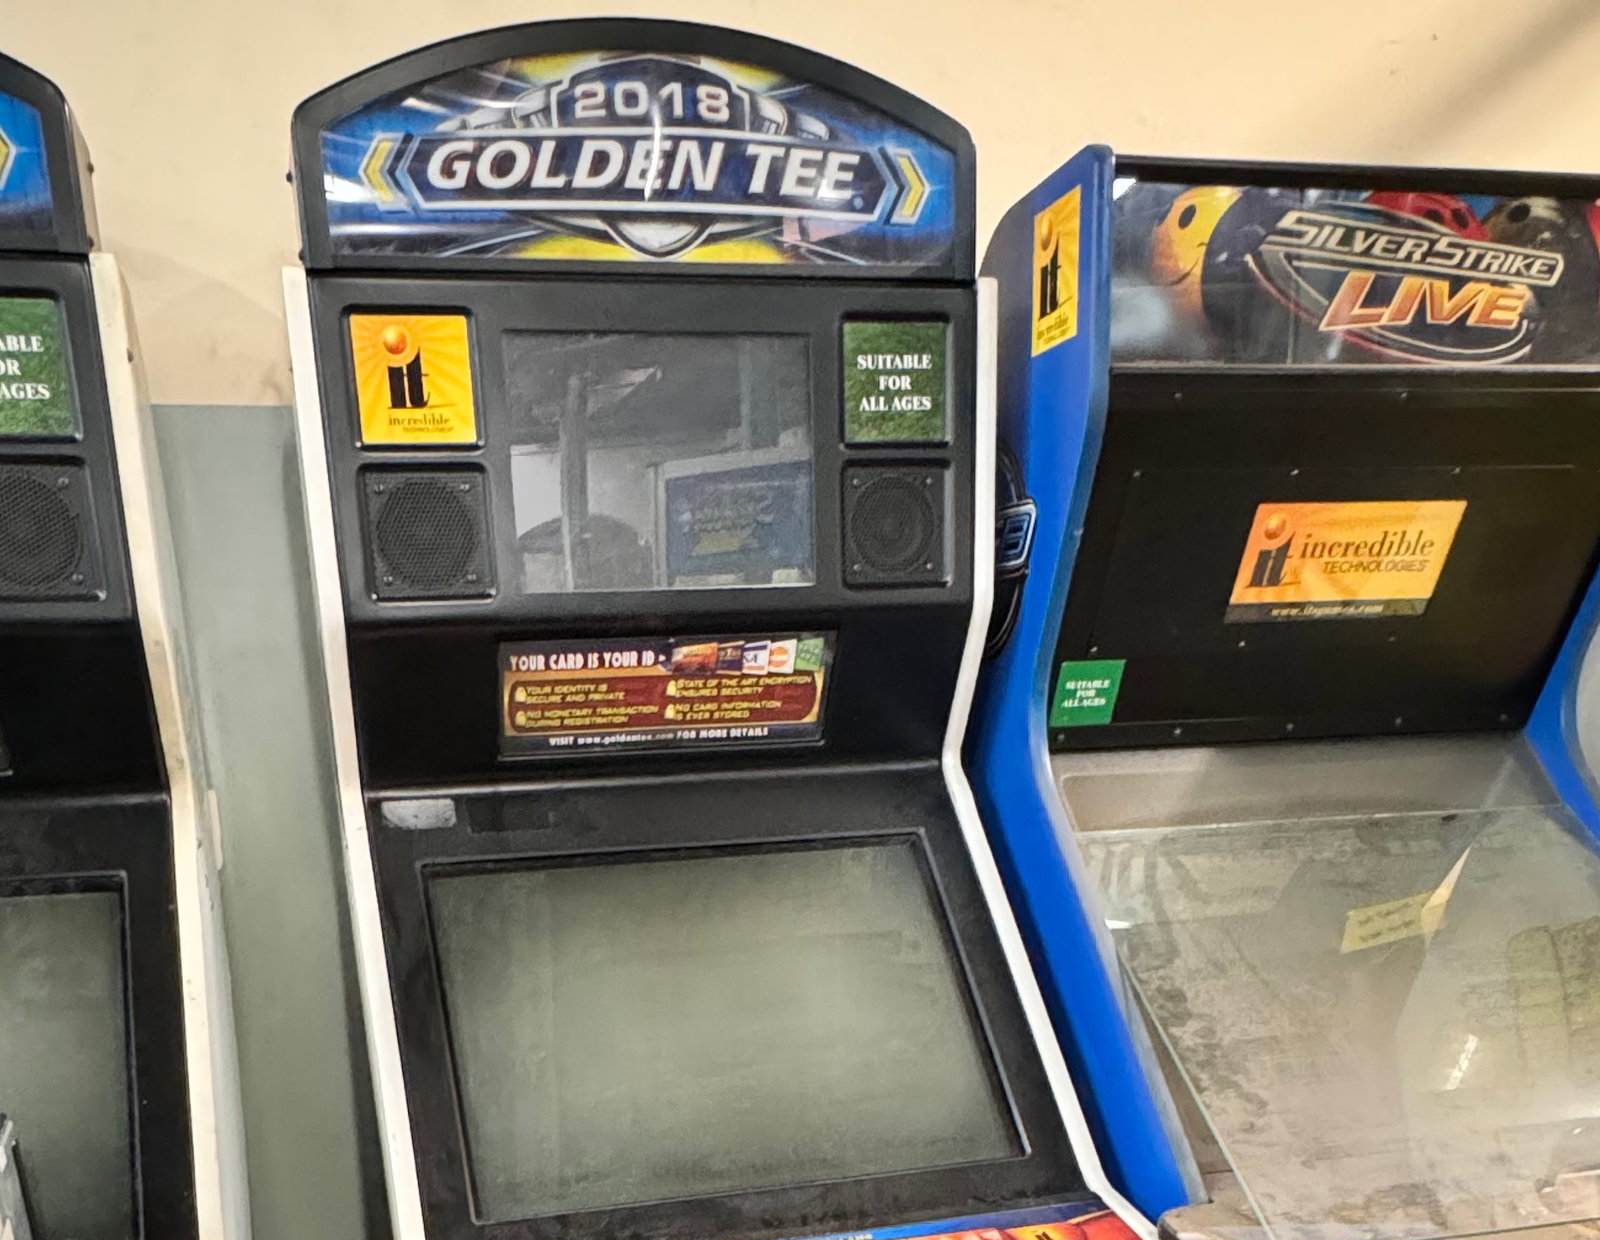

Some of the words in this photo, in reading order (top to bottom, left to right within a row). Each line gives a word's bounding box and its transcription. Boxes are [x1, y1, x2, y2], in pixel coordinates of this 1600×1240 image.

[573, 81, 731, 123] 2018
[426, 138, 720, 191] GOLDEN
[746, 145, 861, 199] TEE
[1319, 270, 1531, 331] LIVE
[856, 354, 932, 370] SUITABLE
[878, 375, 912, 391] FOR
[859, 396, 888, 412] ALL
[891, 396, 932, 411] AGES
[1300, 530, 1435, 559] incredible
[1322, 559, 1430, 575] TECHNOLOGIES
[510, 654, 545, 671] YOUR
[550, 652, 584, 670] CARD
[588, 652, 599, 669] IS
[603, 651, 638, 668] YOUR
[642, 650, 655, 667] ID
[549, 736, 574, 746] VISIT
[676, 729, 697, 739] FOR
[699, 728, 727, 739] MORE
[730, 727, 768, 737] DETAILS
